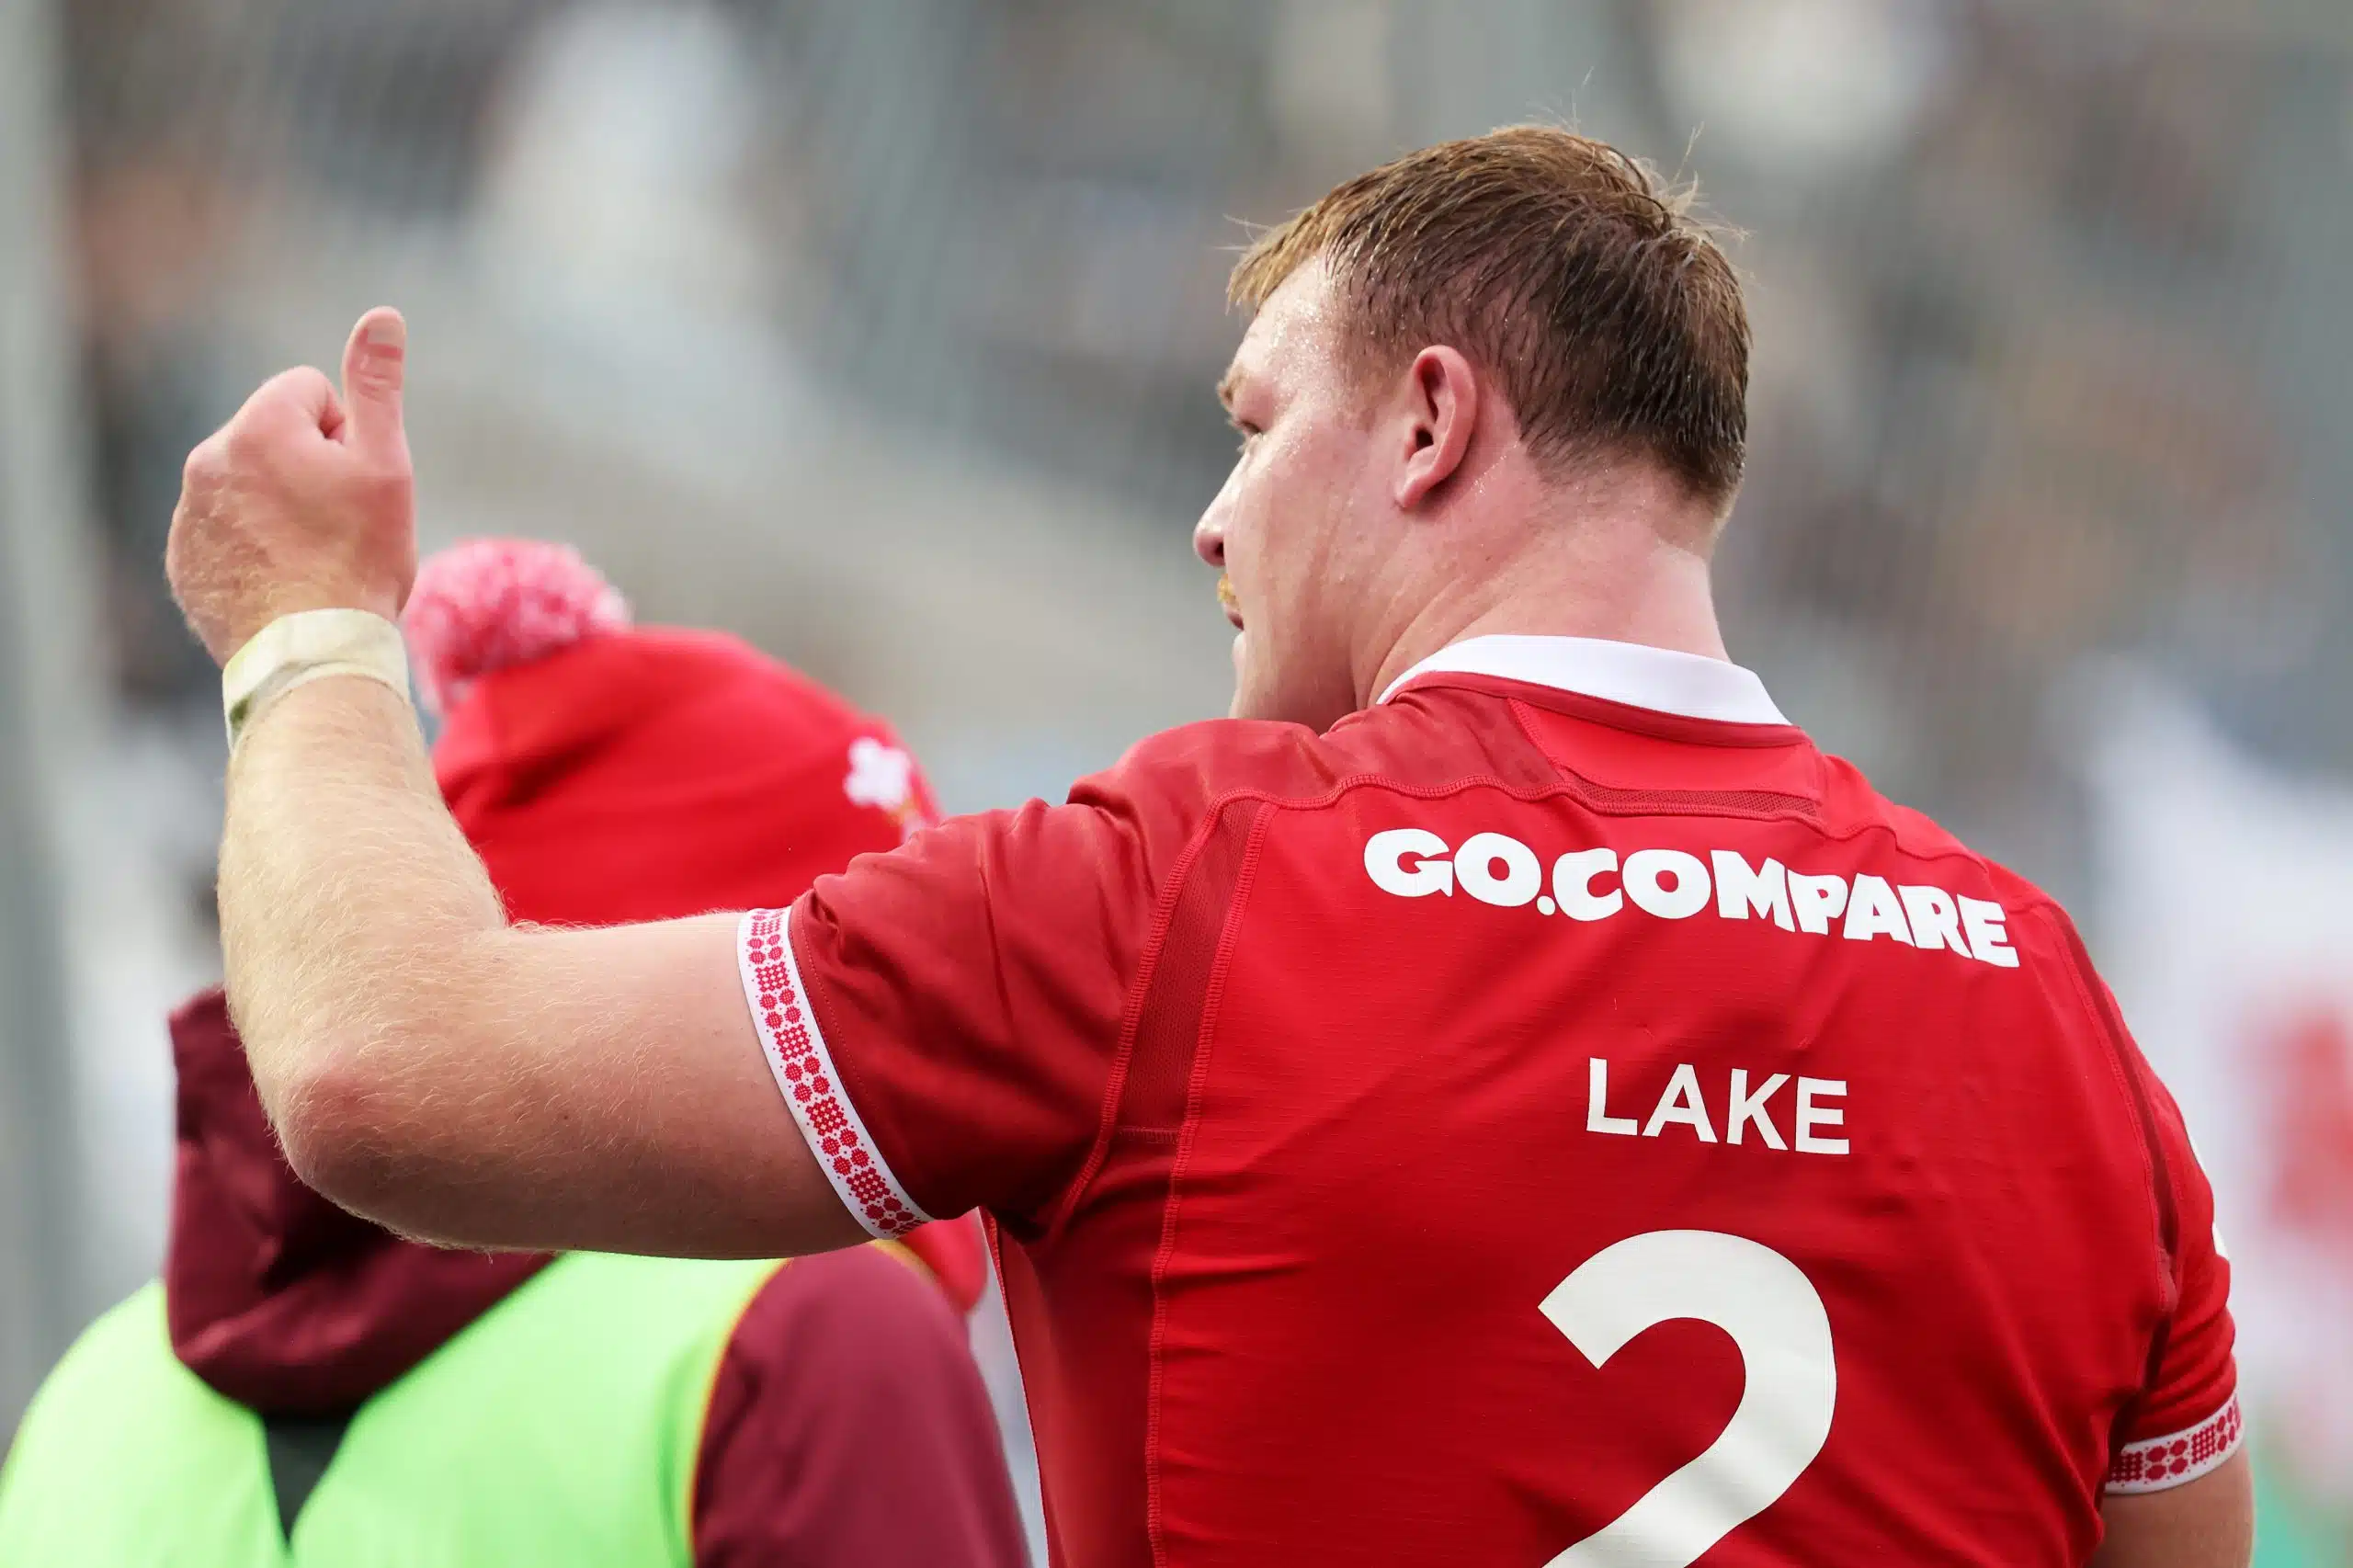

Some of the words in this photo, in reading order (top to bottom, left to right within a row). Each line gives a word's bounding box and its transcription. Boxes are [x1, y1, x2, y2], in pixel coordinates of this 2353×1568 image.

[1364, 829, 2019, 968] GO.COMPARE
[1586, 1058, 1849, 1155] LAKE
[1538, 1230, 1837, 1568] 2
